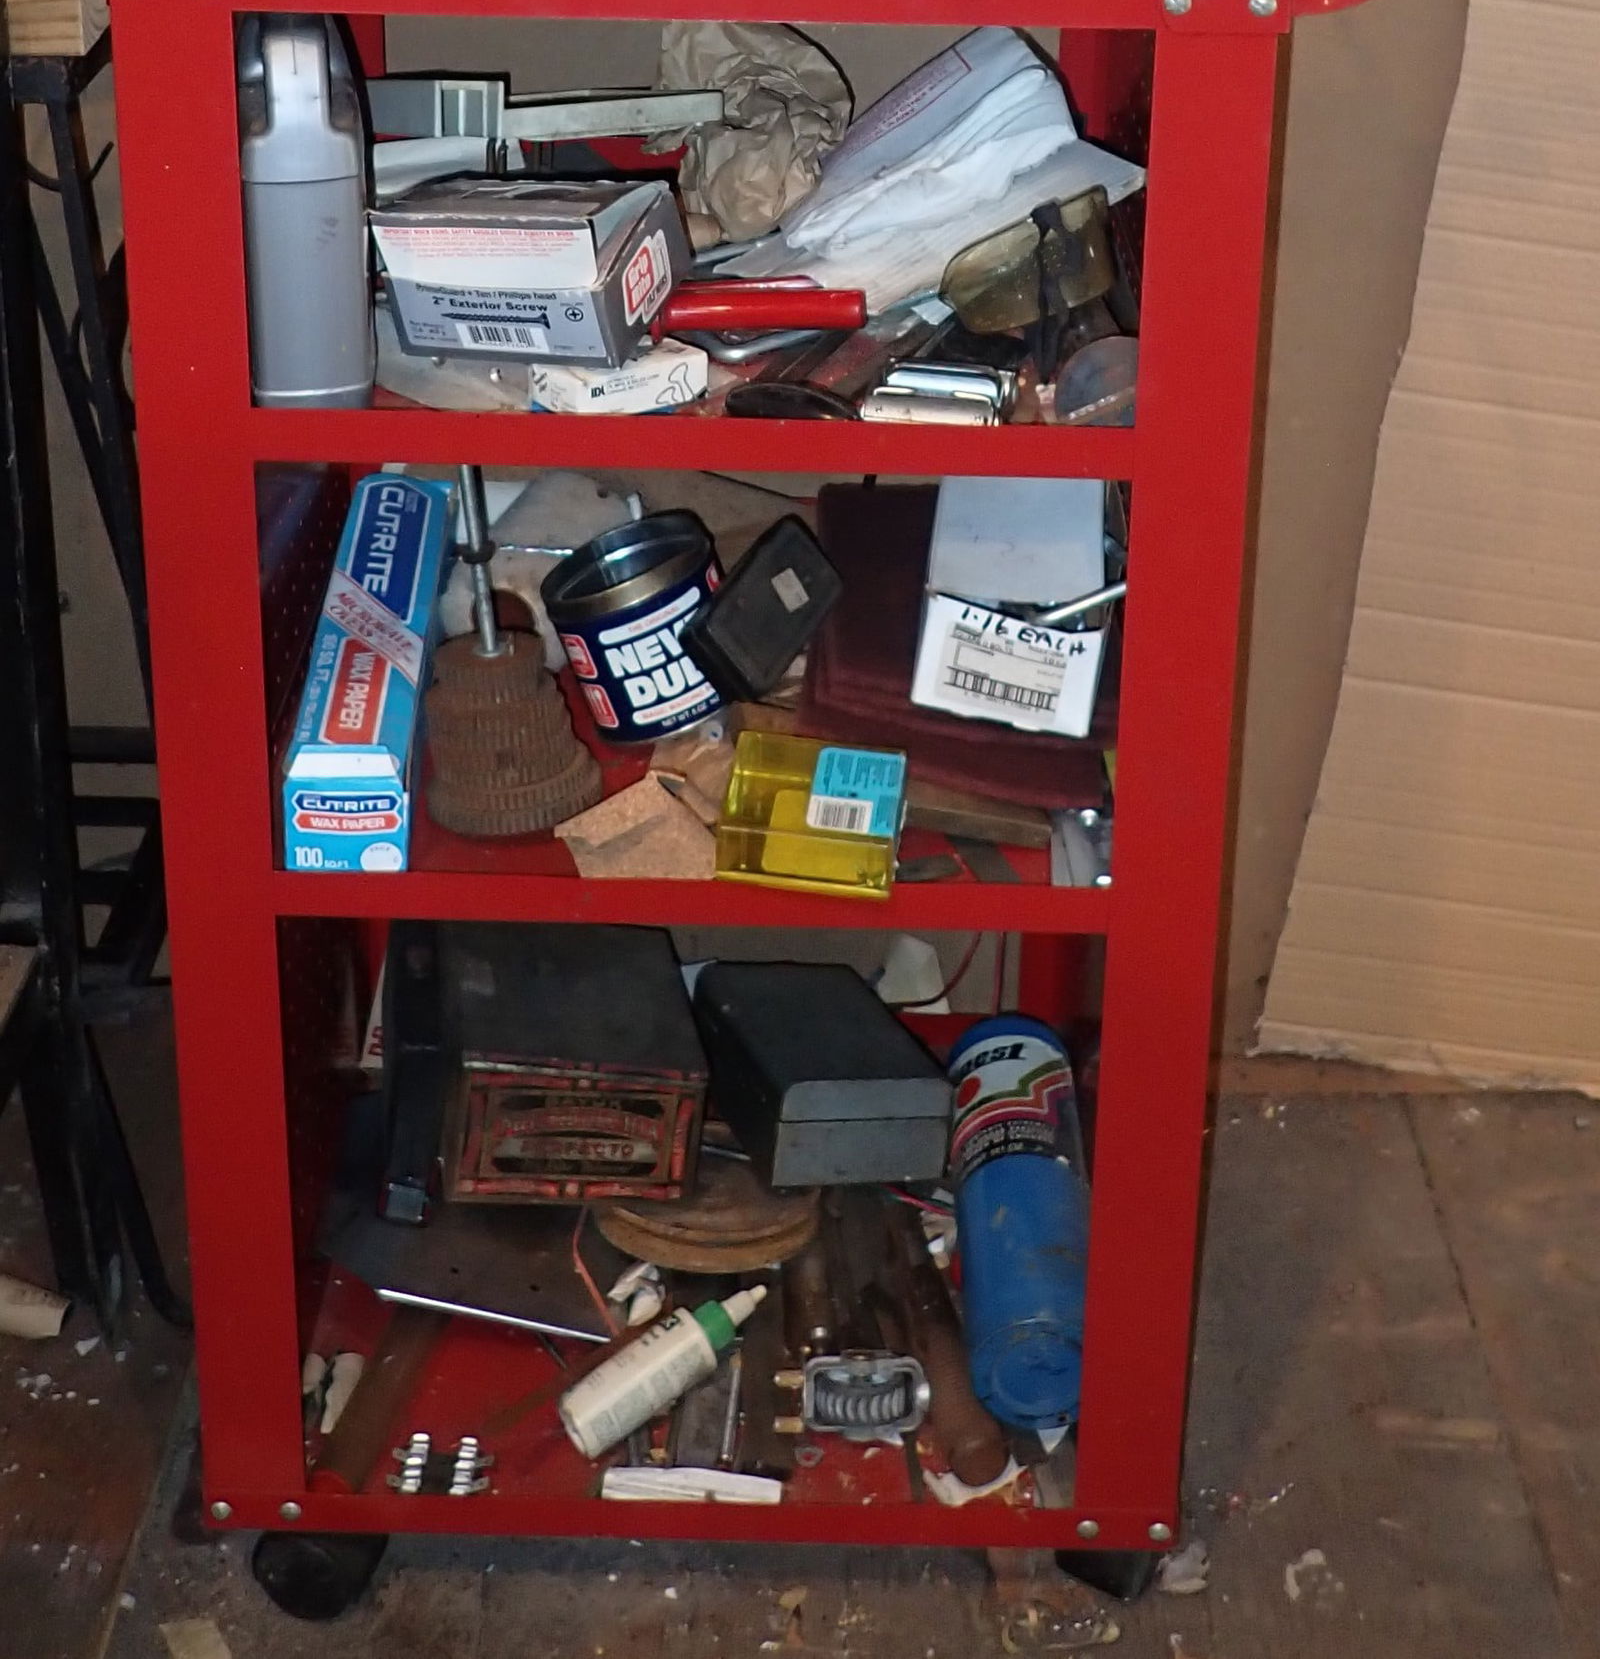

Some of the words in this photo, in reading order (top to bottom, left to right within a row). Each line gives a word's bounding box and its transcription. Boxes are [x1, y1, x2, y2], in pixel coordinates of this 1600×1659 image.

[450, 298, 501, 310] Exterior
[505, 300, 548, 312] Screw
[604, 607, 699, 678] NEV
[1017, 626, 1086, 657] EACH
[351, 651, 377, 682] WAX
[623, 655, 706, 708] DUL
[338, 681, 370, 731] PAPER
[310, 816, 340, 830] WAX
[342, 816, 386, 830] PAPER
[294, 846, 323, 868] 100
